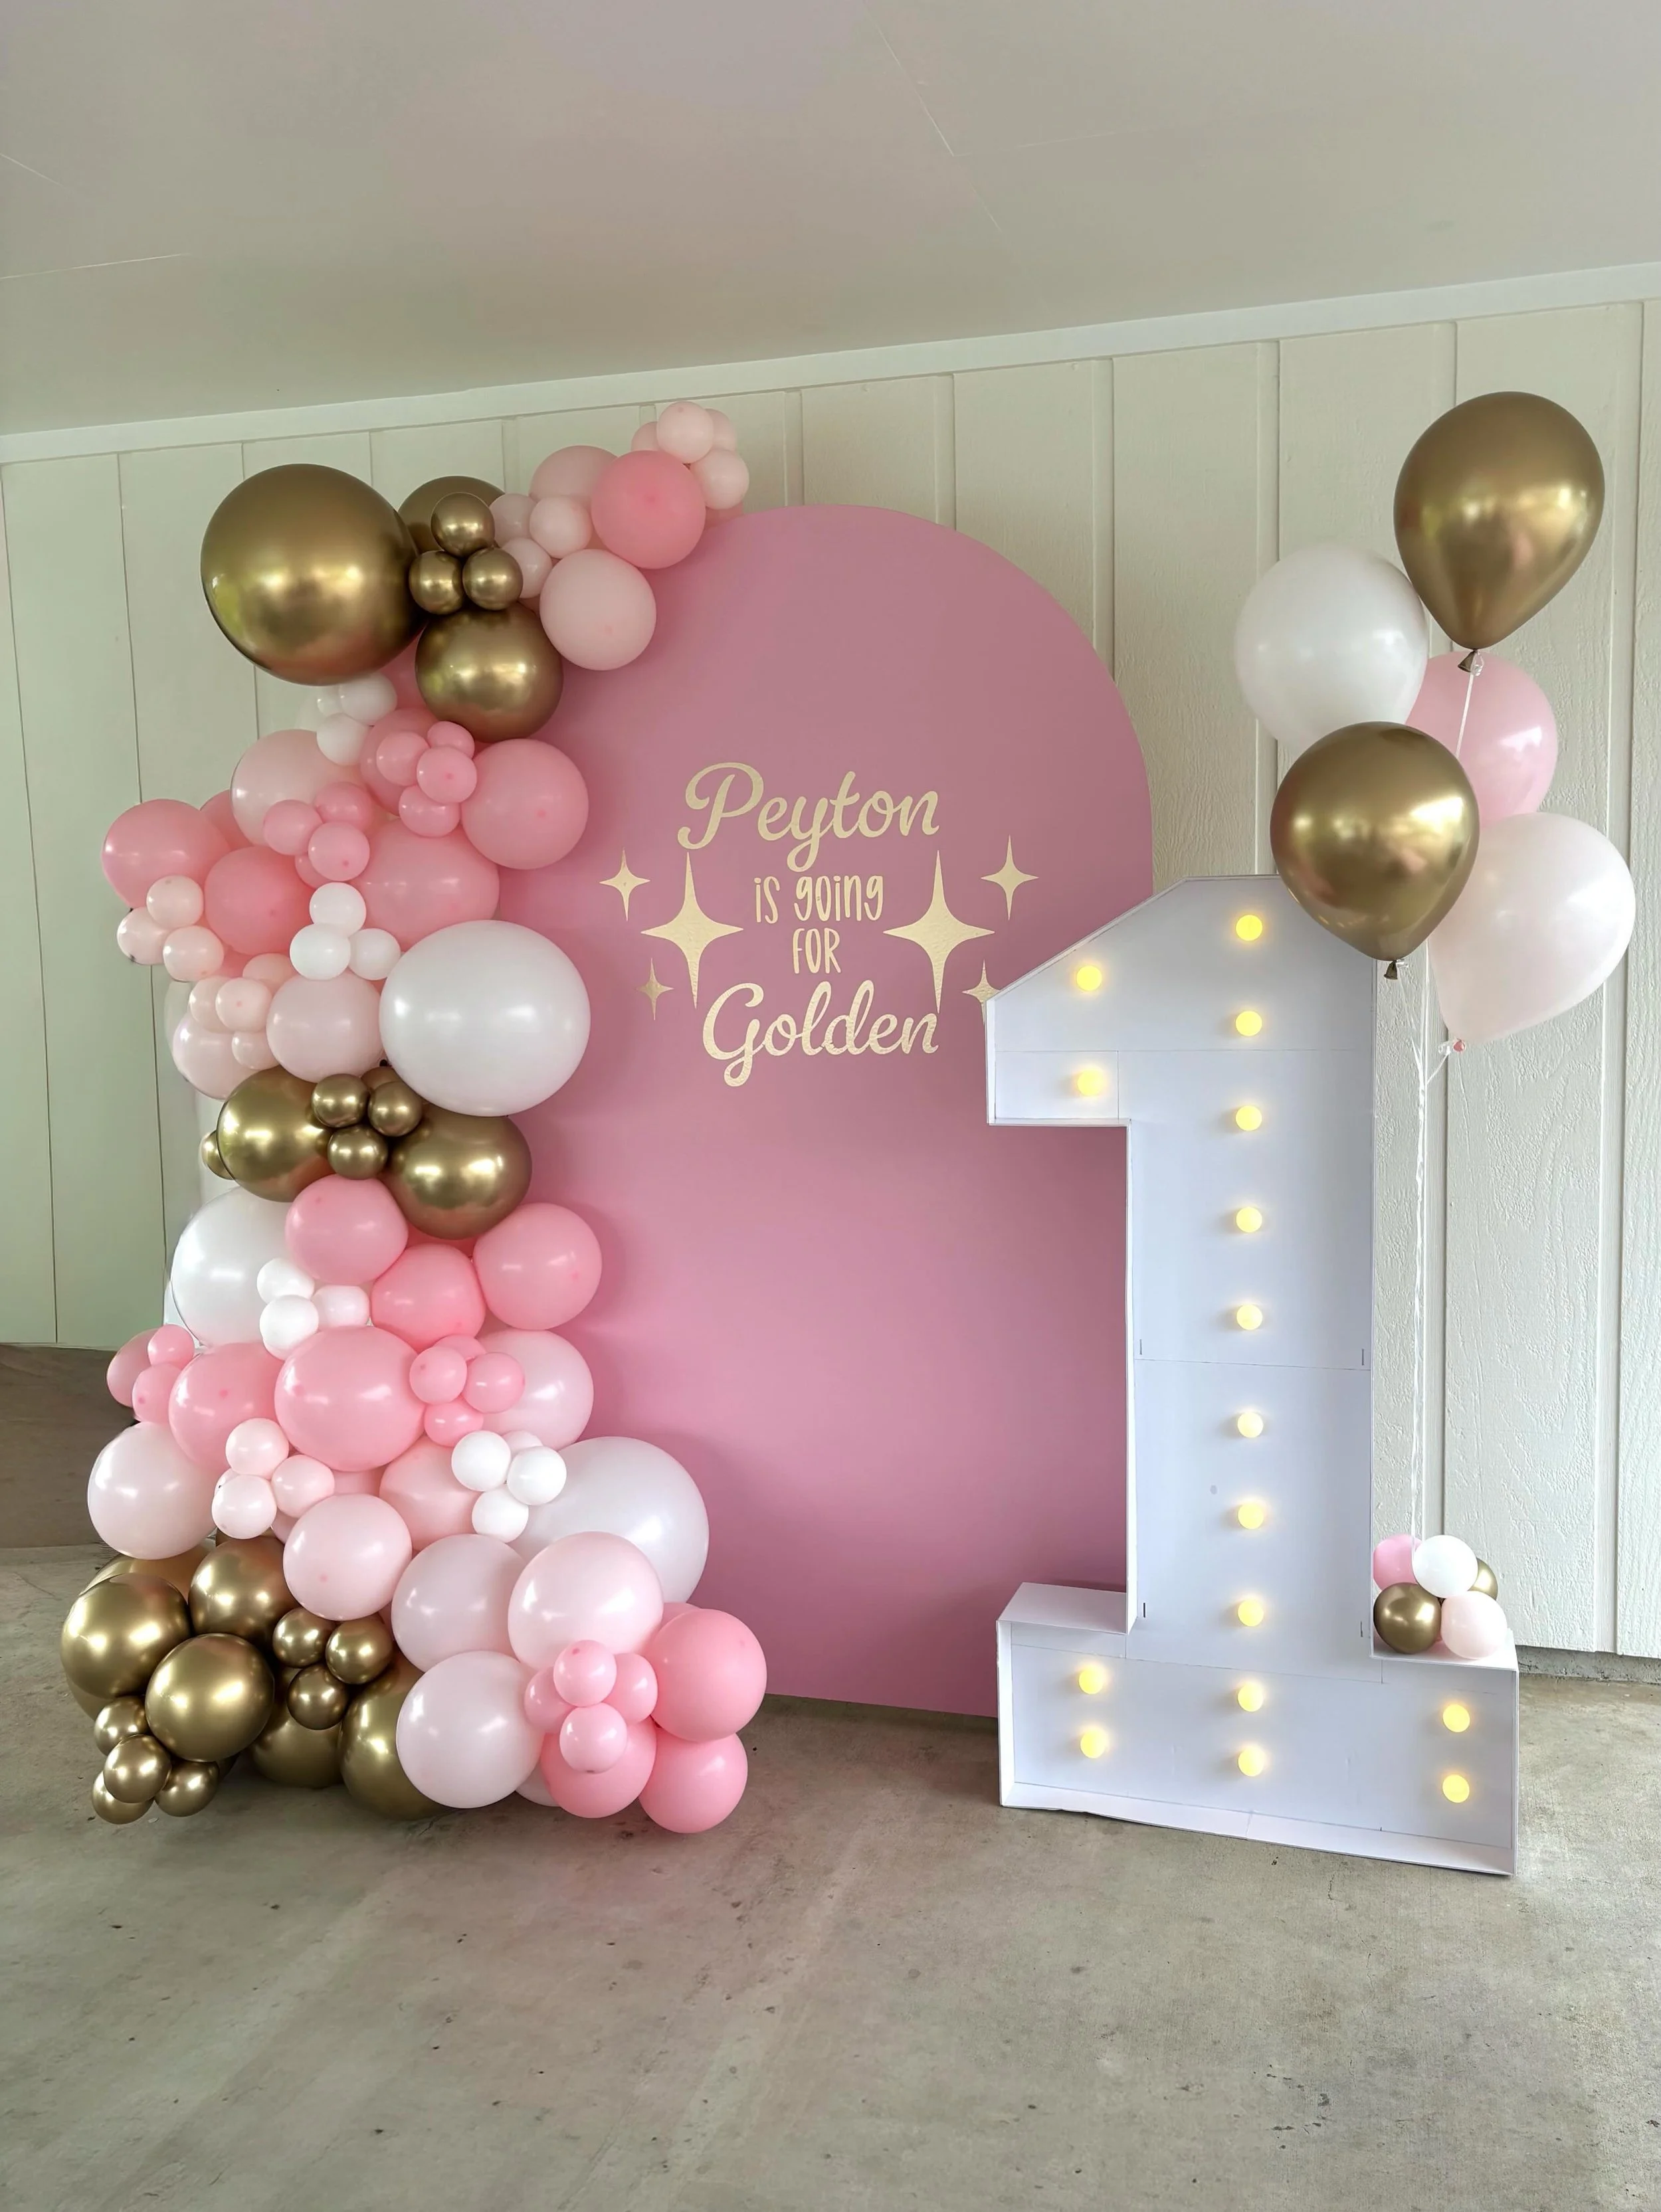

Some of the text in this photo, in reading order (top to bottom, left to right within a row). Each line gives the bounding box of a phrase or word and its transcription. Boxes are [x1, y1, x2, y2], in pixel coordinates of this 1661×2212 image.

[677, 762, 939, 872] Peyton
[793, 927, 841, 974] FOR
[794, 875, 884, 922] going
[702, 980, 939, 1087] Golden
[986, 875, 1518, 1876] 1
